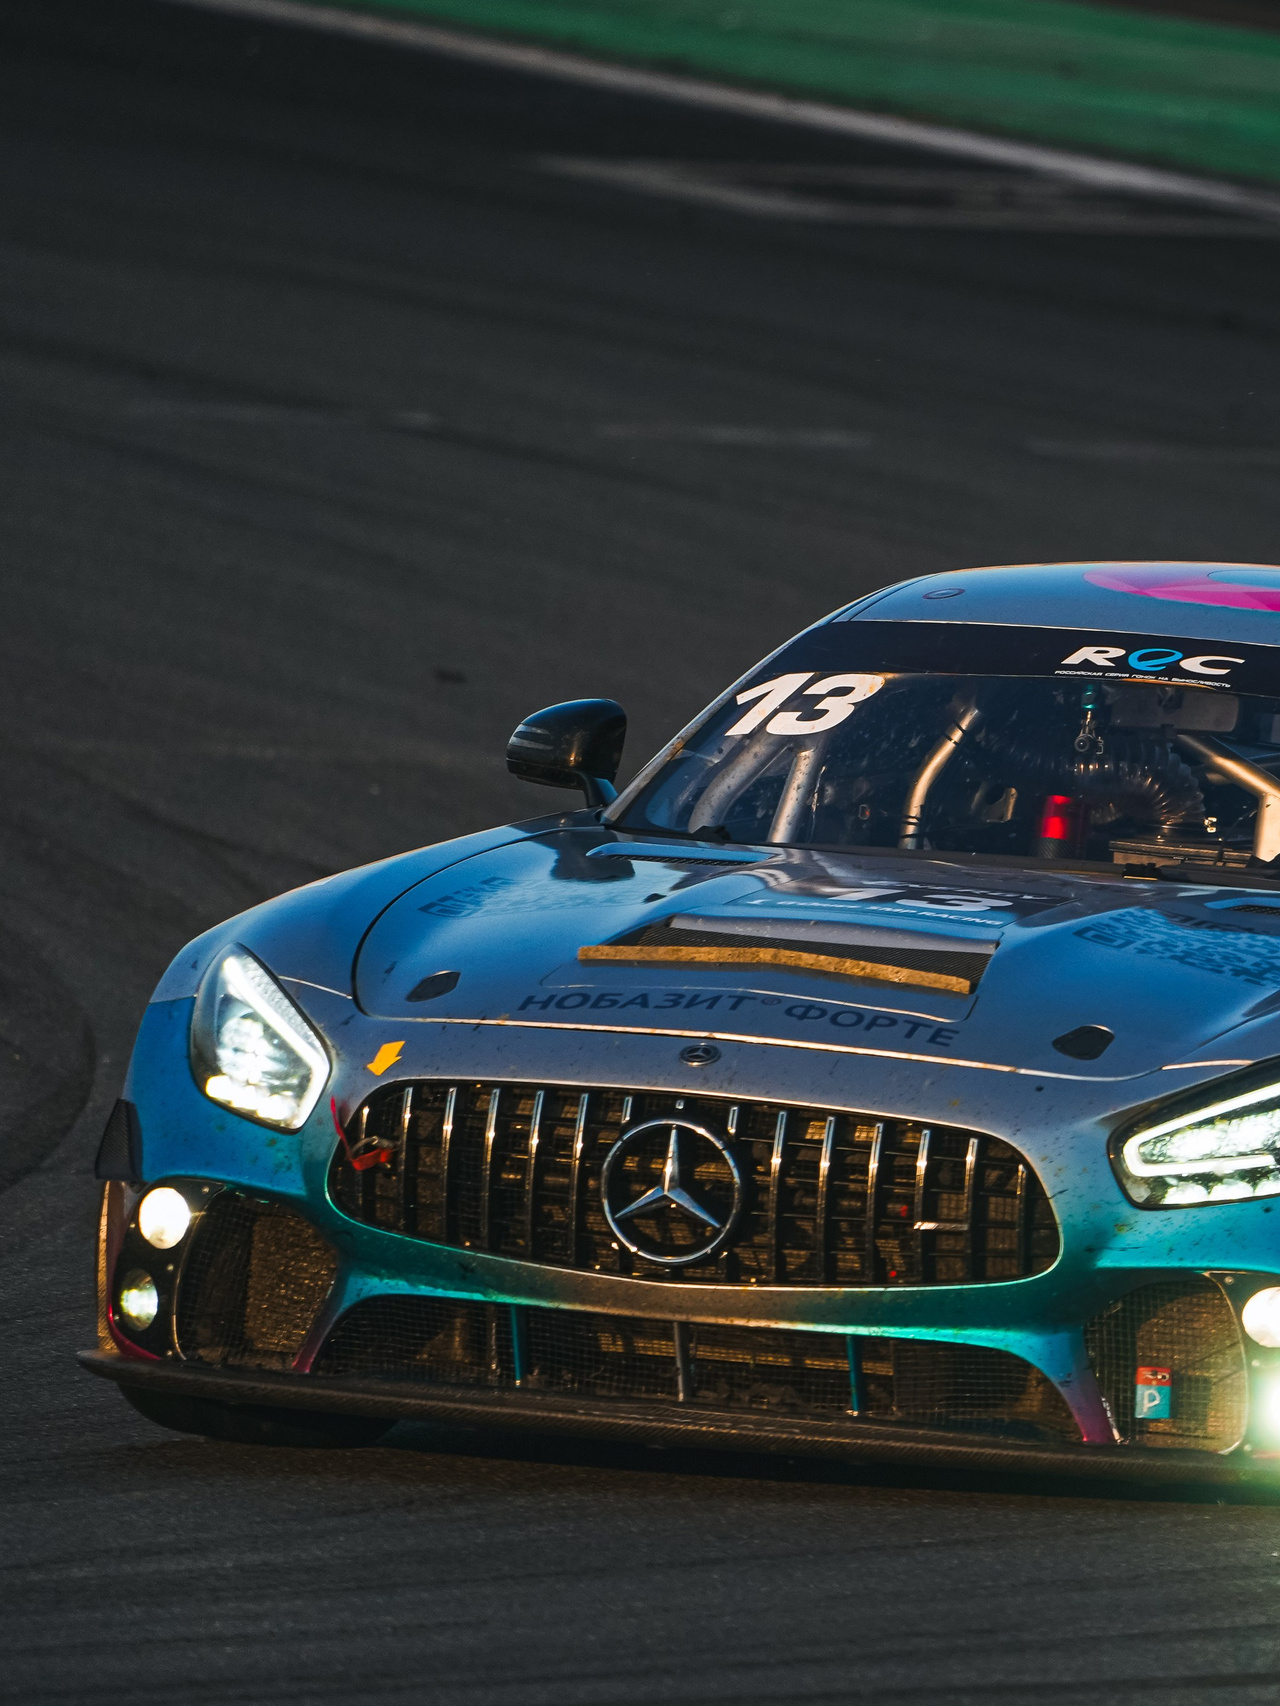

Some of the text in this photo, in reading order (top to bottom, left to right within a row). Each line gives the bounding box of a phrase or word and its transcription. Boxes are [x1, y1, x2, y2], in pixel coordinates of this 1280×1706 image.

[724, 672, 886, 736] 13
[820, 887, 1014, 912] 13
[864, 905, 918, 914] SMP
[917, 911, 1005, 926] RACING
[784, 1003, 960, 1047] ФОРТЕ
